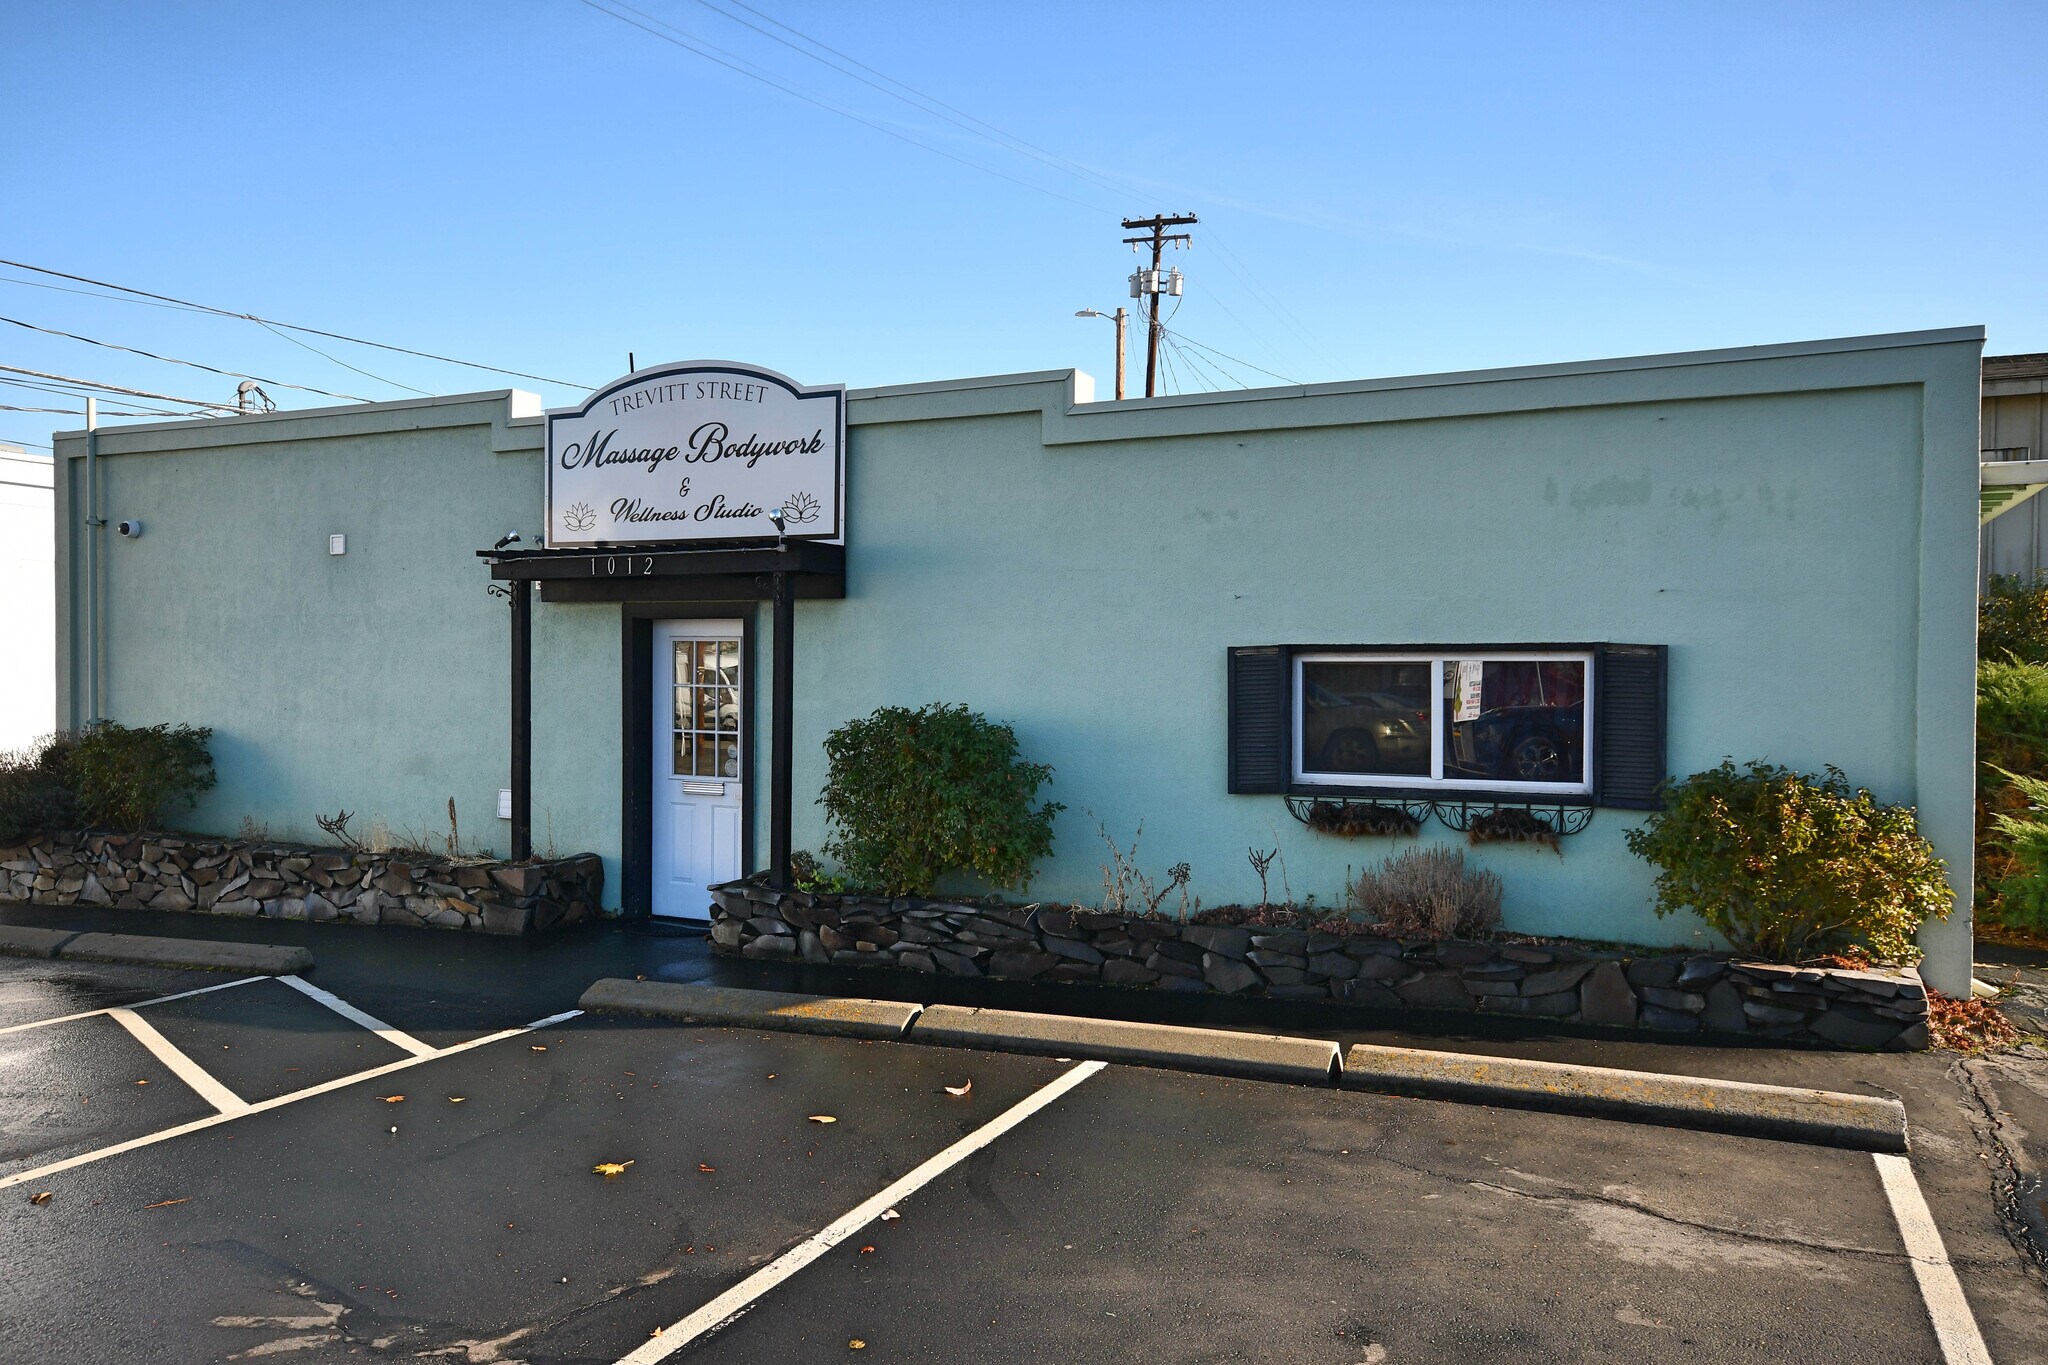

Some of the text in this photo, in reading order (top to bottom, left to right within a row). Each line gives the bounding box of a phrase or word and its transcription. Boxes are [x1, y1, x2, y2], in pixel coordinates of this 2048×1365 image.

[609, 381, 769, 416] TREVITT STREET
[561, 422, 826, 473] Massage Bodywork
[679, 477, 691, 498] &
[610, 494, 764, 523] Wellness Studio
[590, 556, 653, 576] 1012
